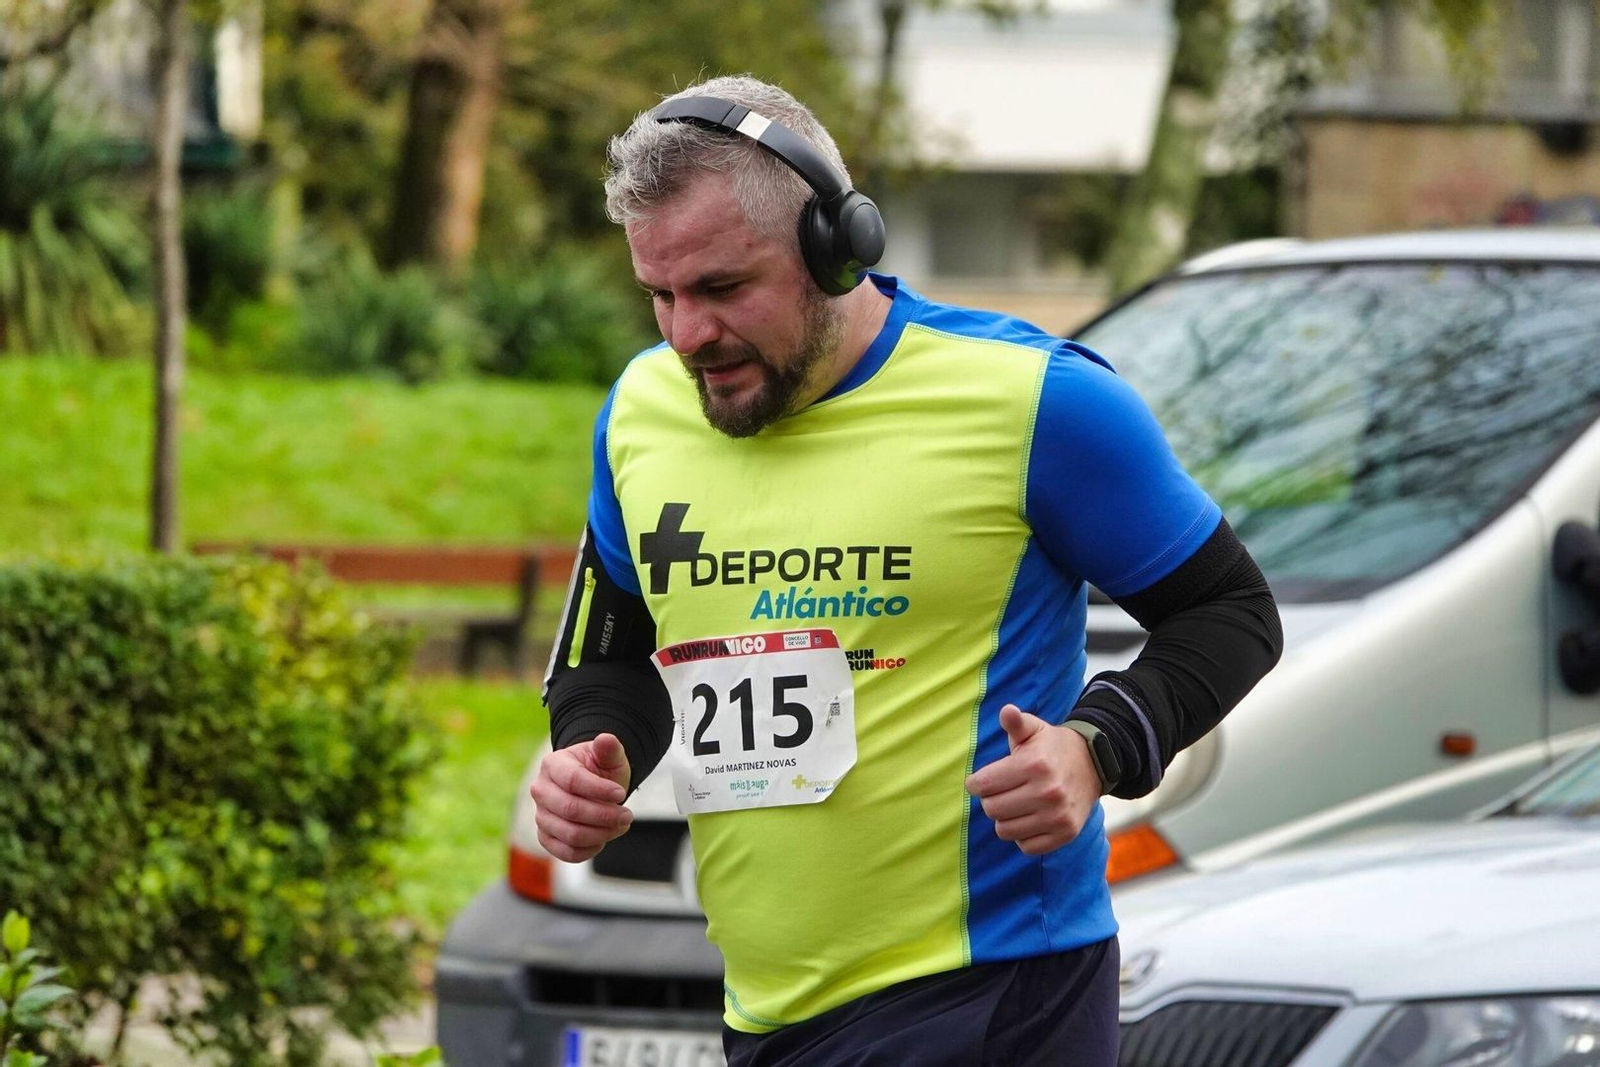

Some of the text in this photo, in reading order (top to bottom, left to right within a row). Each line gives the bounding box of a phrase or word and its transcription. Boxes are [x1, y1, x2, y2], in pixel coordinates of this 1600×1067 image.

[690, 546, 912, 587] DEPORTE
[750, 586, 910, 620] Atlántico
[599, 612, 615, 655] HAISSKY
[845, 649, 874, 660] RUN
[692, 674, 814, 756] 215
[705, 758, 797, 774] David MARTINEZ NOVAS
